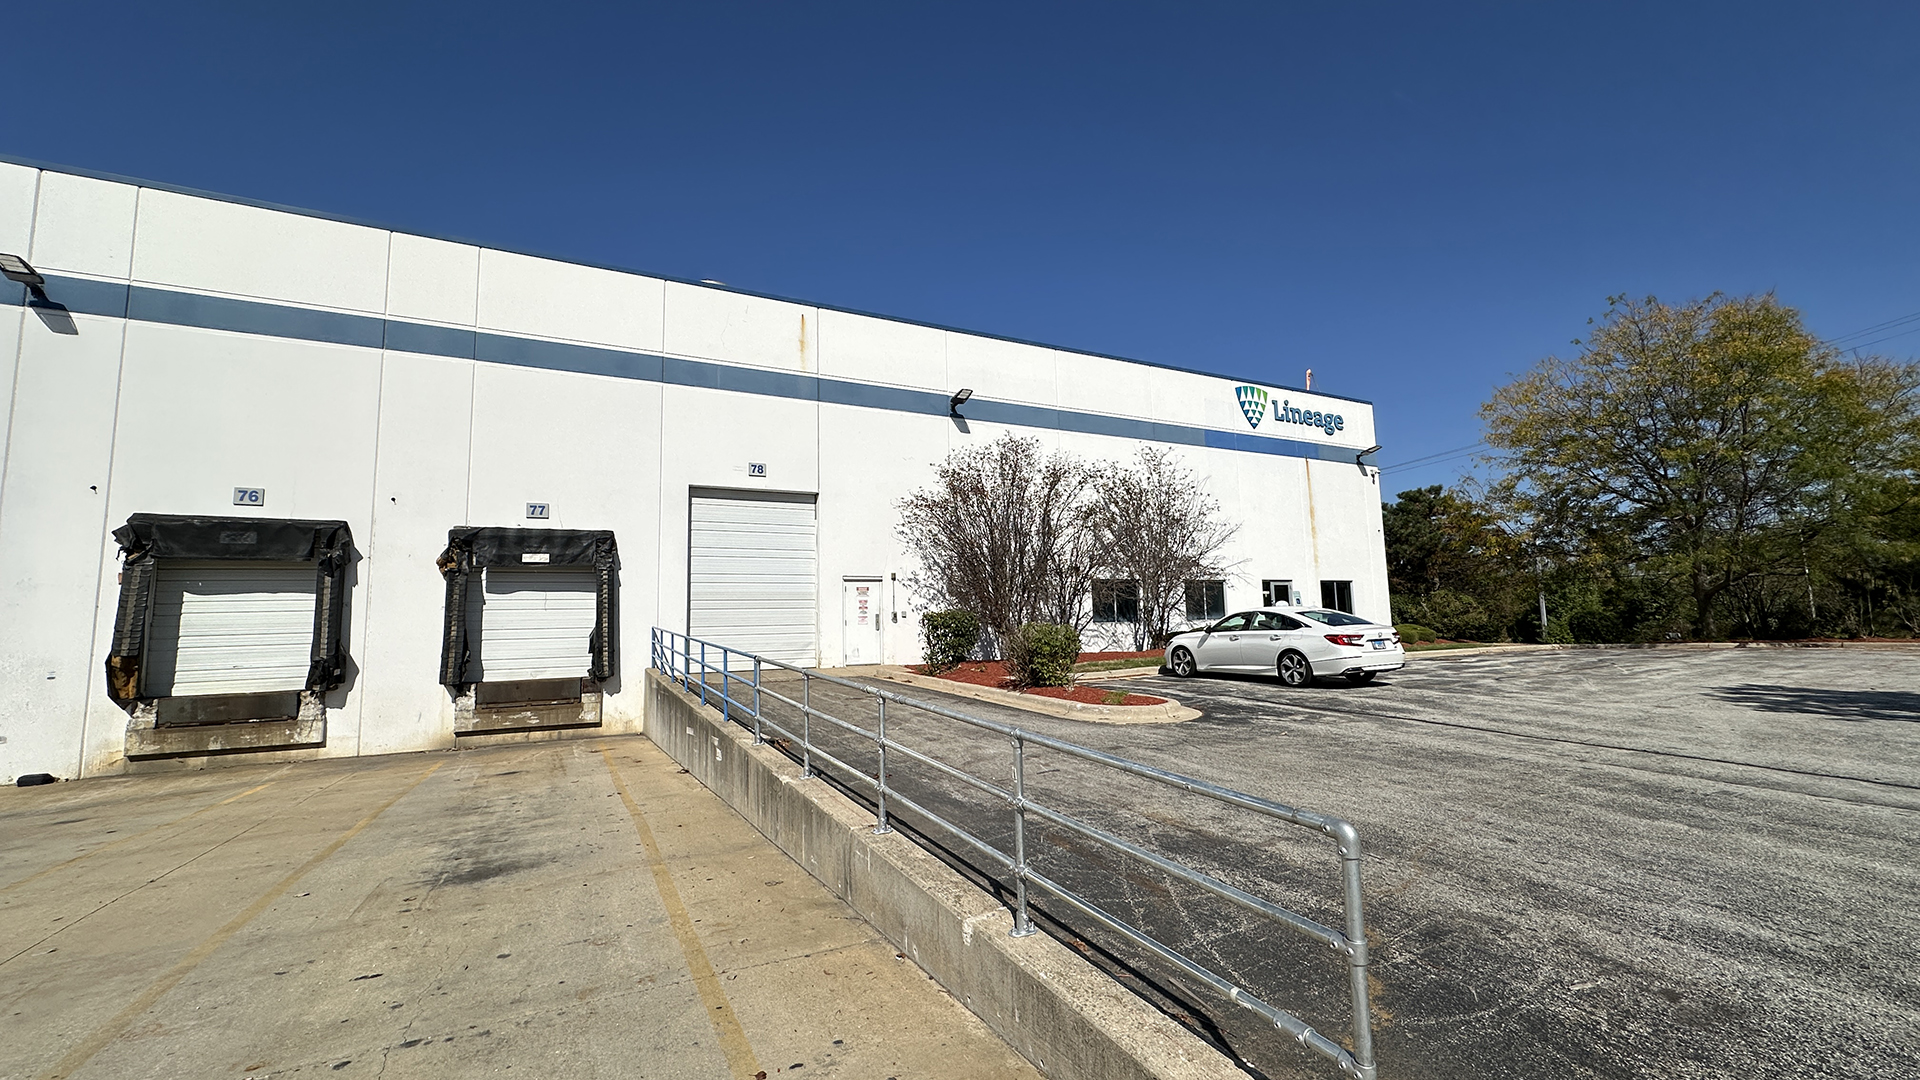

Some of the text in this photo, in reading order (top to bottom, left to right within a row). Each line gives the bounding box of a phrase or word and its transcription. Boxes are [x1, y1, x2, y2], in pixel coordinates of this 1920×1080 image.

[1271, 399, 1344, 436] Lineage
[751, 464, 764, 474] 78
[237, 490, 259, 502] 76
[529, 505, 546, 515] 77
